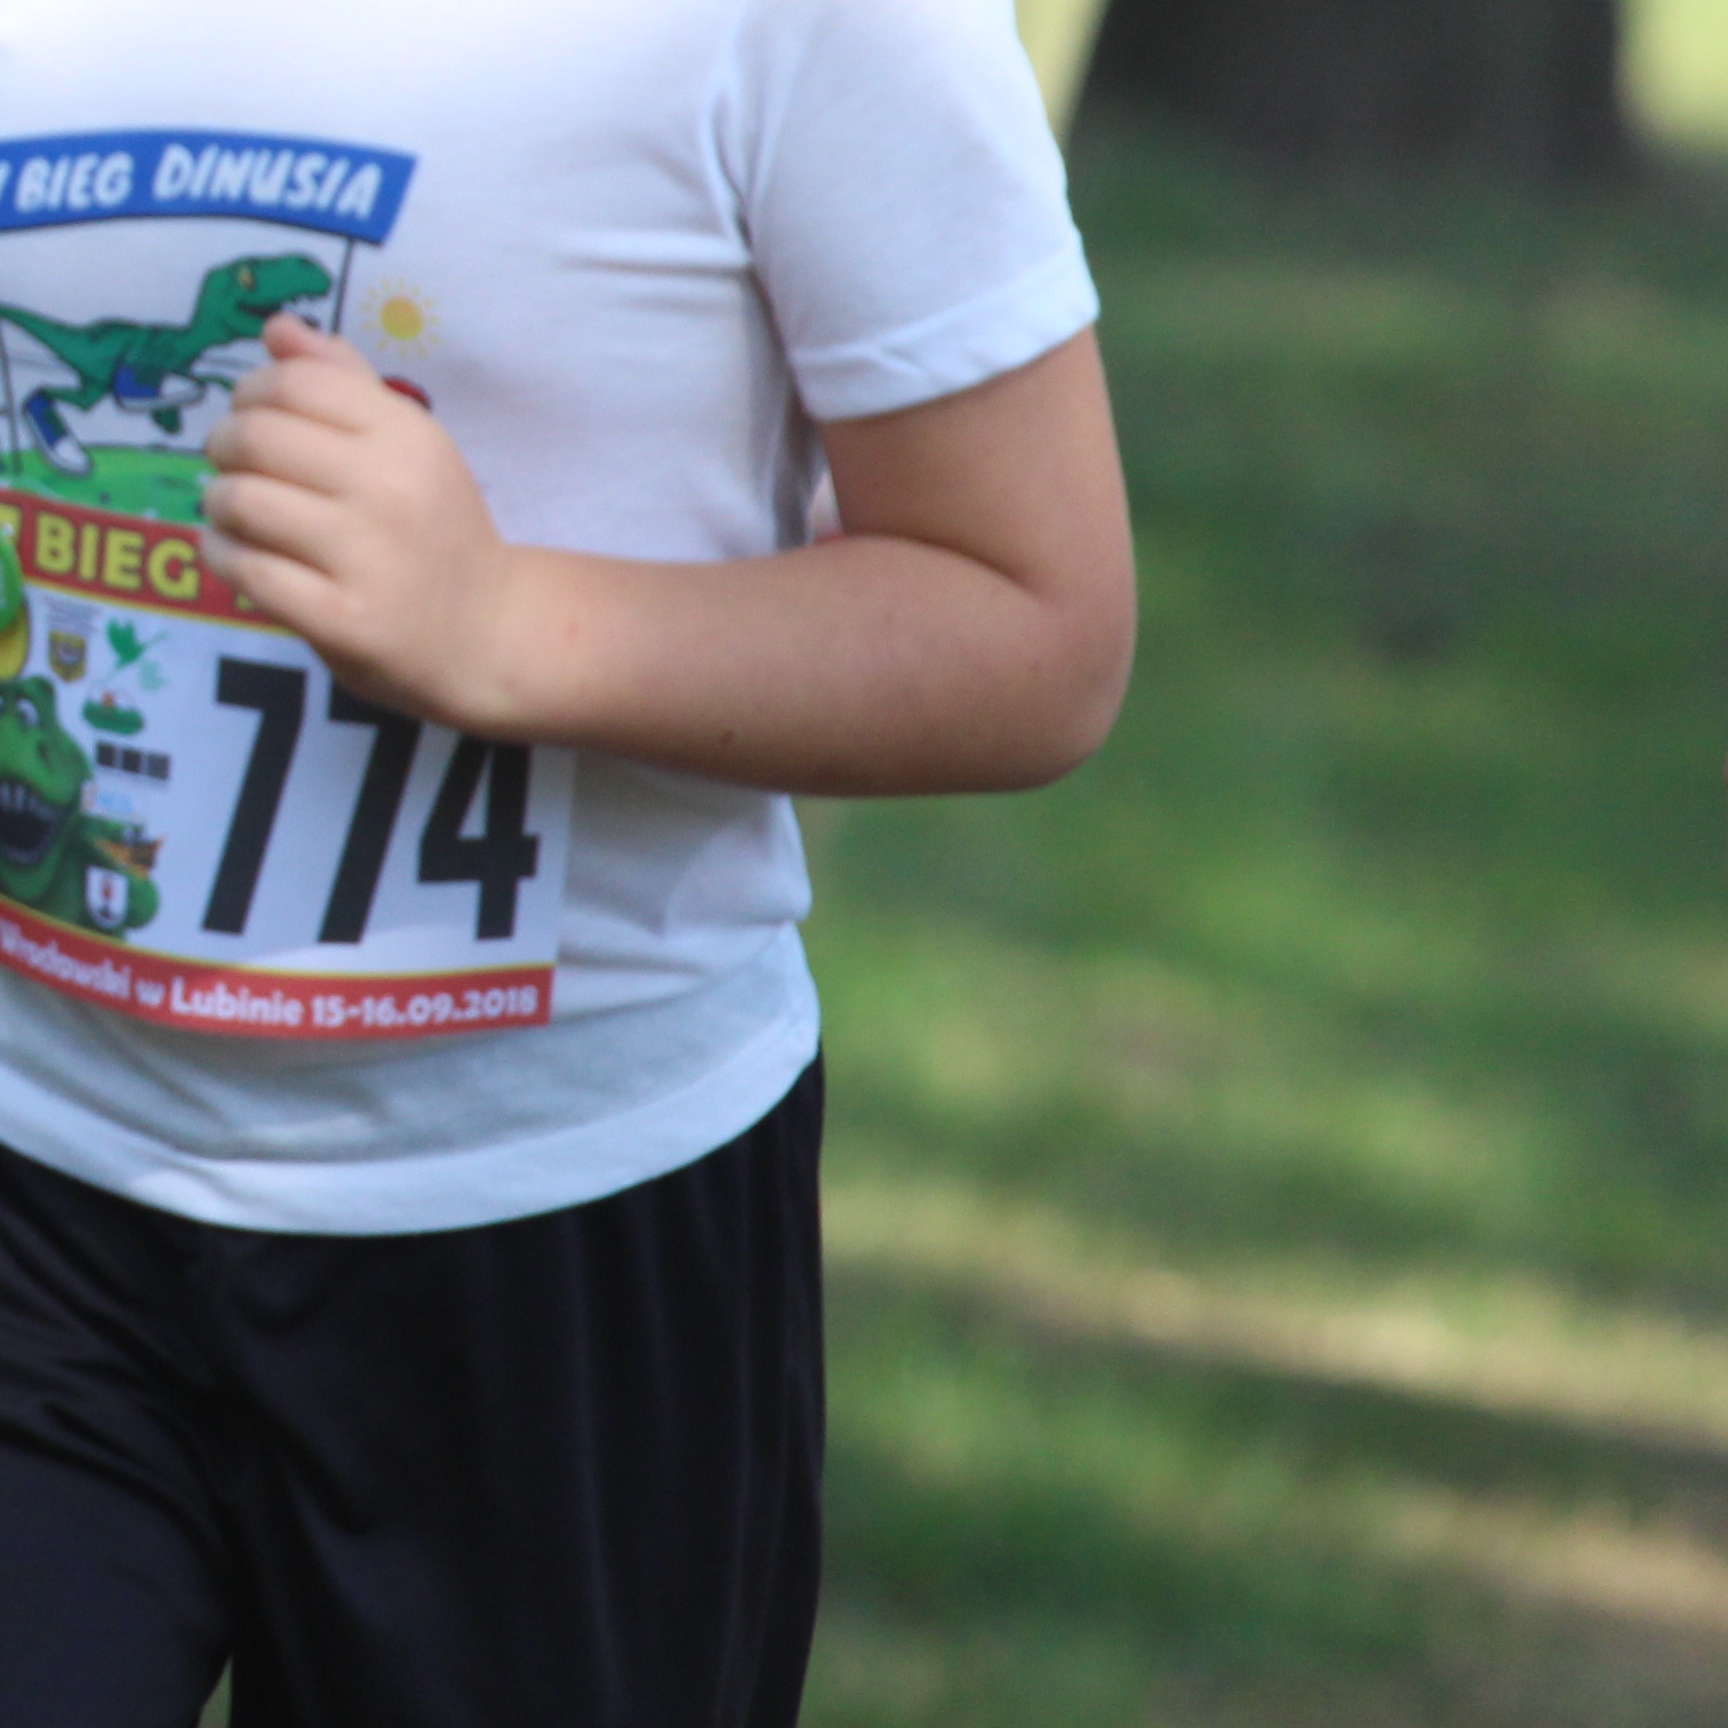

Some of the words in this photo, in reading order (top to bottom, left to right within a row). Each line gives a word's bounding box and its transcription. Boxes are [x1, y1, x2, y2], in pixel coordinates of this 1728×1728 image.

[15, 150, 135, 214] BIEG
[151, 142, 384, 222] DINUSIA
[33, 511, 200, 602] BIEG
[200, 654, 541, 945] 774
[134, 978, 167, 1008] w
[169, 975, 305, 1027] Lubinie
[311, 983, 539, 1029] 15-16.09.2018
